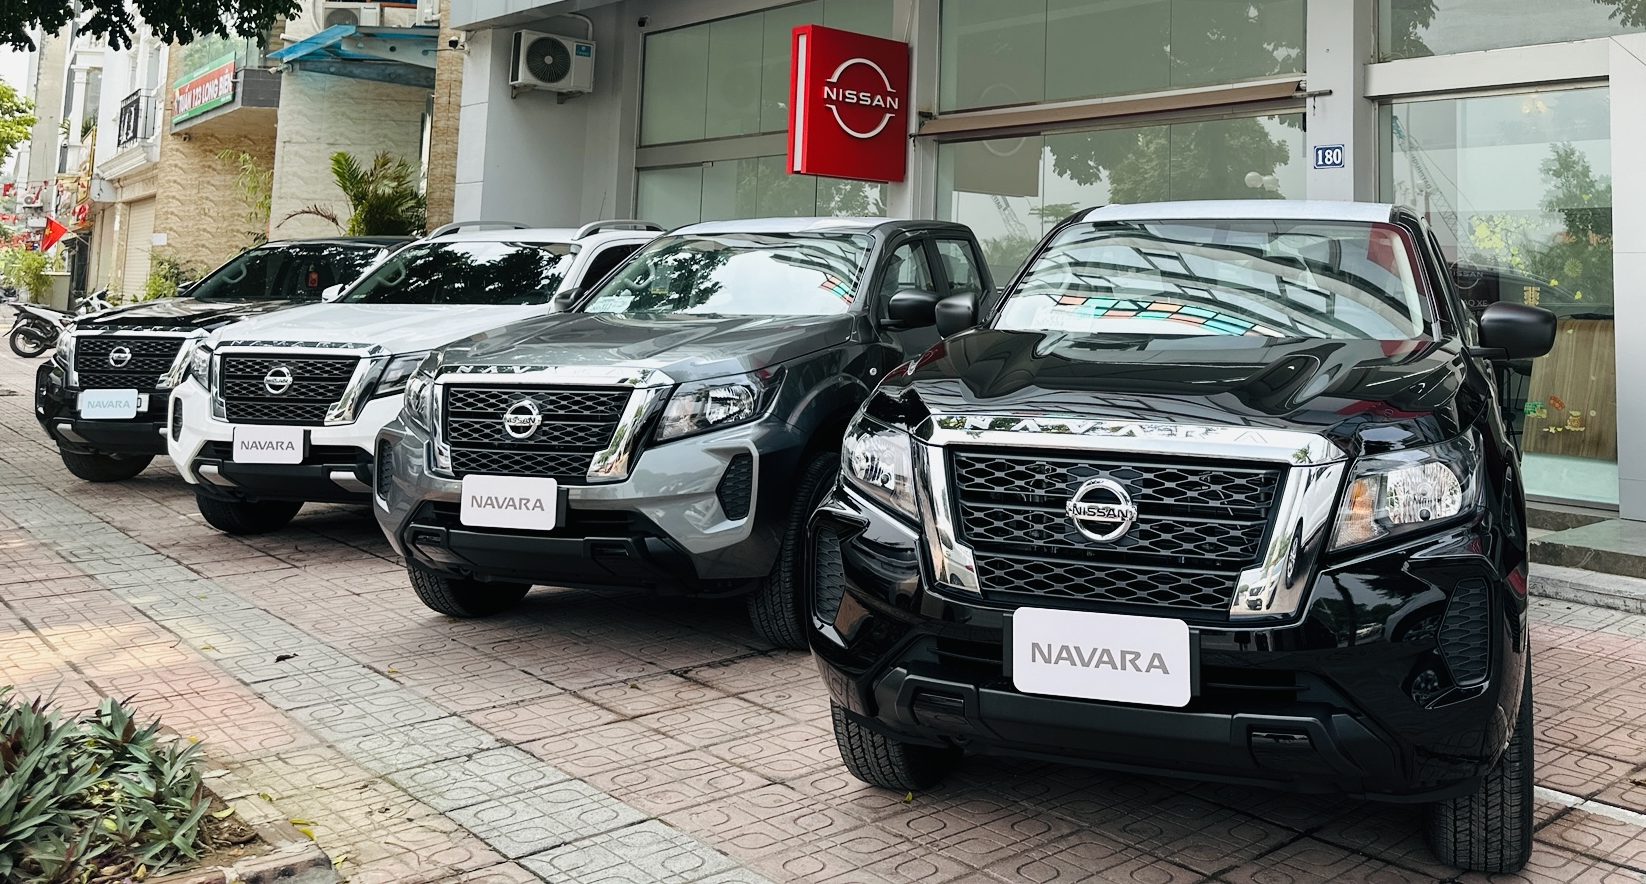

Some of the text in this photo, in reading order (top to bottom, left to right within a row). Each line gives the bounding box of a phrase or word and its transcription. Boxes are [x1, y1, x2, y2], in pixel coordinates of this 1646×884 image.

[193, 87, 202, 108] 123
[202, 78, 218, 103] LONG
[823, 86, 899, 110] NISSAN
[1317, 149, 1342, 165] 180
[1453, 270, 1484, 278] ISSAN
[87, 400, 131, 409] NAVARA
[240, 440, 295, 451] NAVARA
[471, 495, 545, 512] NAVARA
[1072, 503, 1129, 521] NISSAN
[1031, 642, 1170, 675] NAVARA
